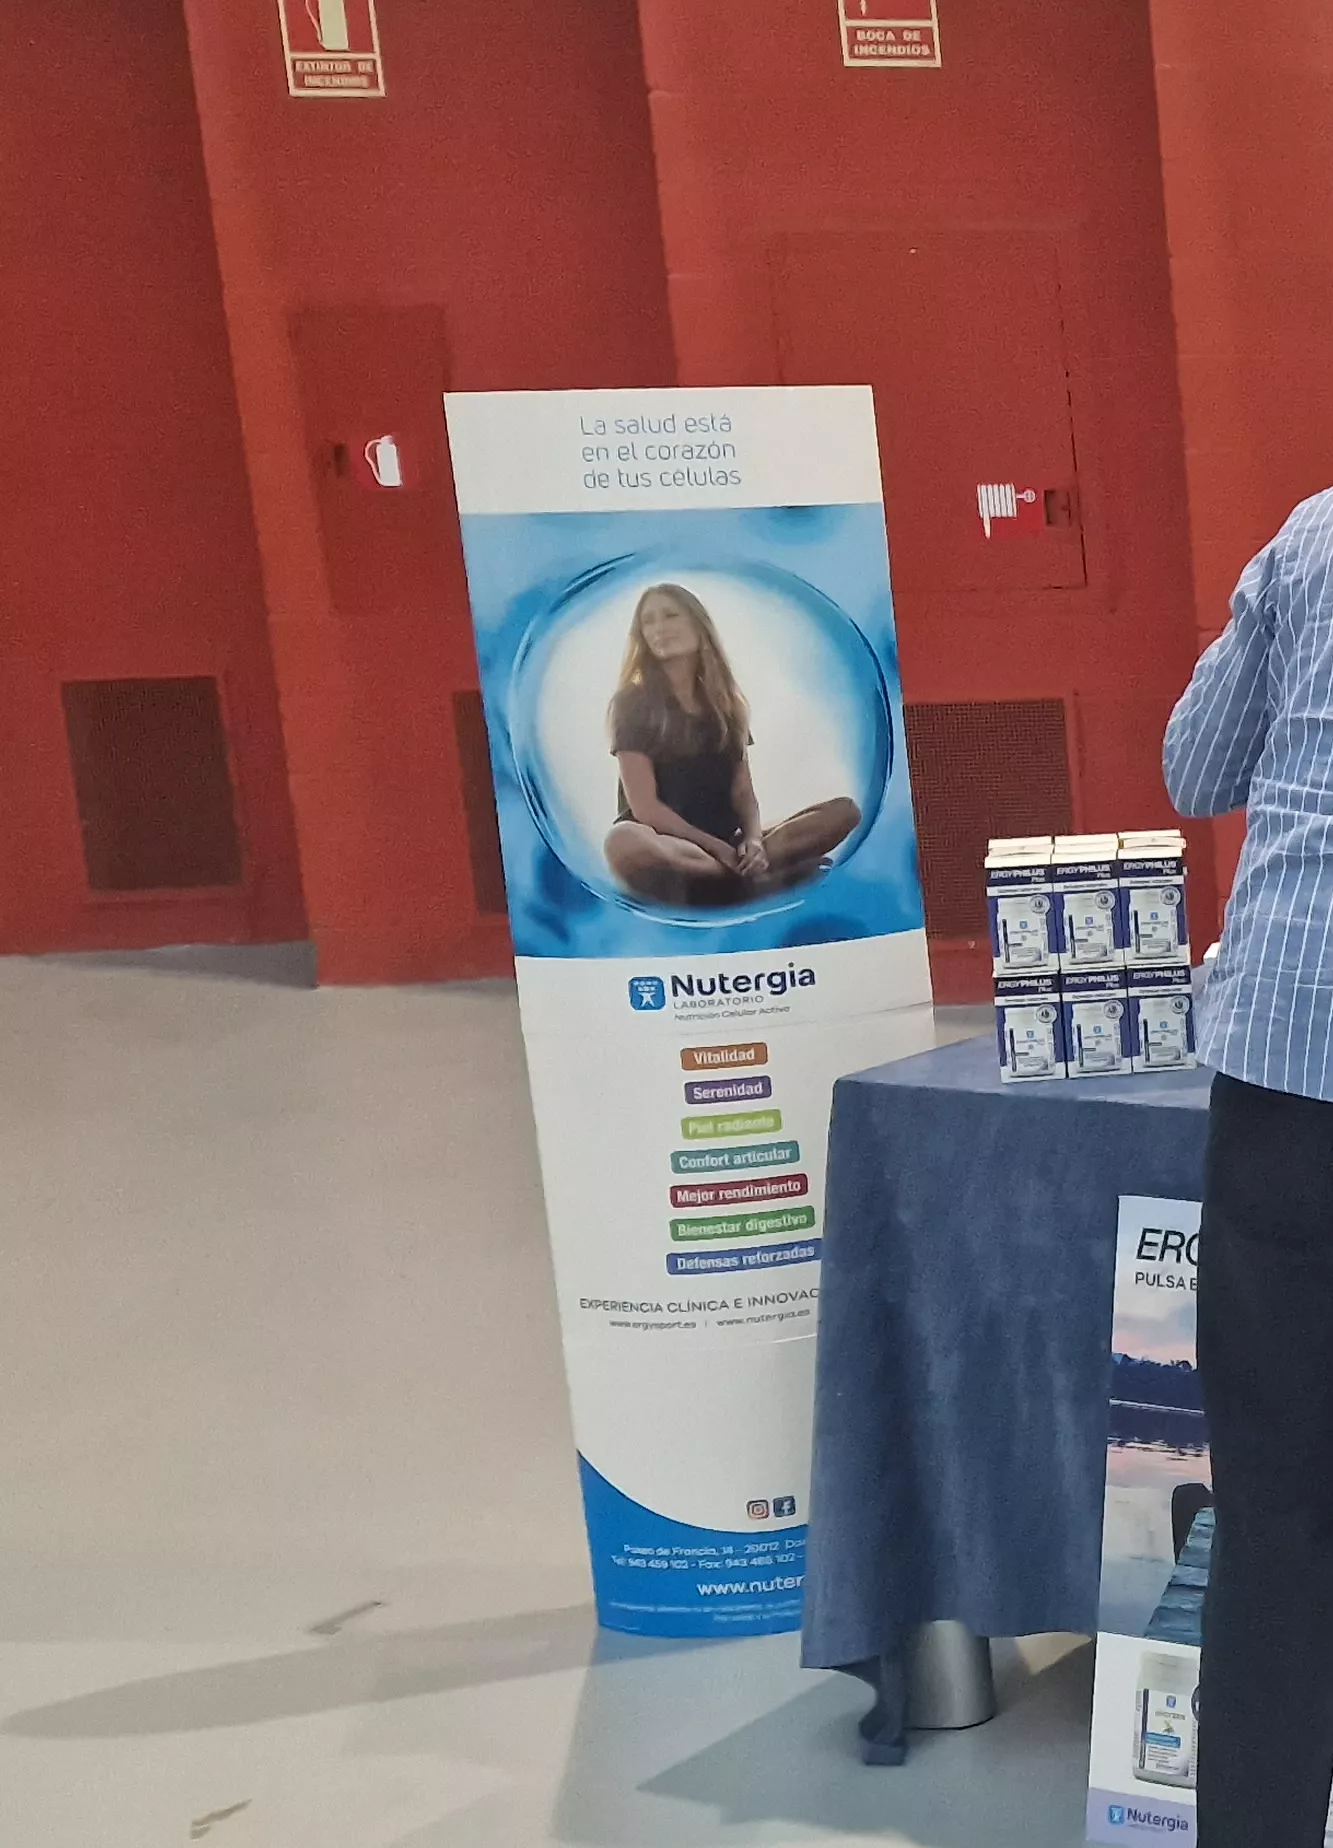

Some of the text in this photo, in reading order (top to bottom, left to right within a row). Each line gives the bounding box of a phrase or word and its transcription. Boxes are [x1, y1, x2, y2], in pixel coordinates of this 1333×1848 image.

[856, 29, 921, 41] BOCA DE
[854, 44, 931, 56] INCENDIOS
[580, 412, 732, 436] La salud está
[582, 441, 736, 462] en el corazón
[583, 466, 742, 489] de tus células
[671, 961, 816, 998] Nutergia
[673, 994, 764, 1010] LABORATORIO
[693, 1047, 756, 1065] Vitalidad
[693, 1081, 763, 1100] Serenidad
[679, 1147, 792, 1169] Confort articular
[677, 1179, 801, 1205] Mejor rendimiento
[677, 1212, 808, 1237] Bienestar digestivo
[676, 1245, 816, 1271] Defensas reforzadas
[1135, 1271, 1187, 1291] PULSA
[579, 1297, 663, 1313] EXPERIENCIA
[667, 1299, 729, 1313] CLÍNICA
[734, 1298, 744, 1309] E
[1127, 1807, 1189, 1832] Nutergia
